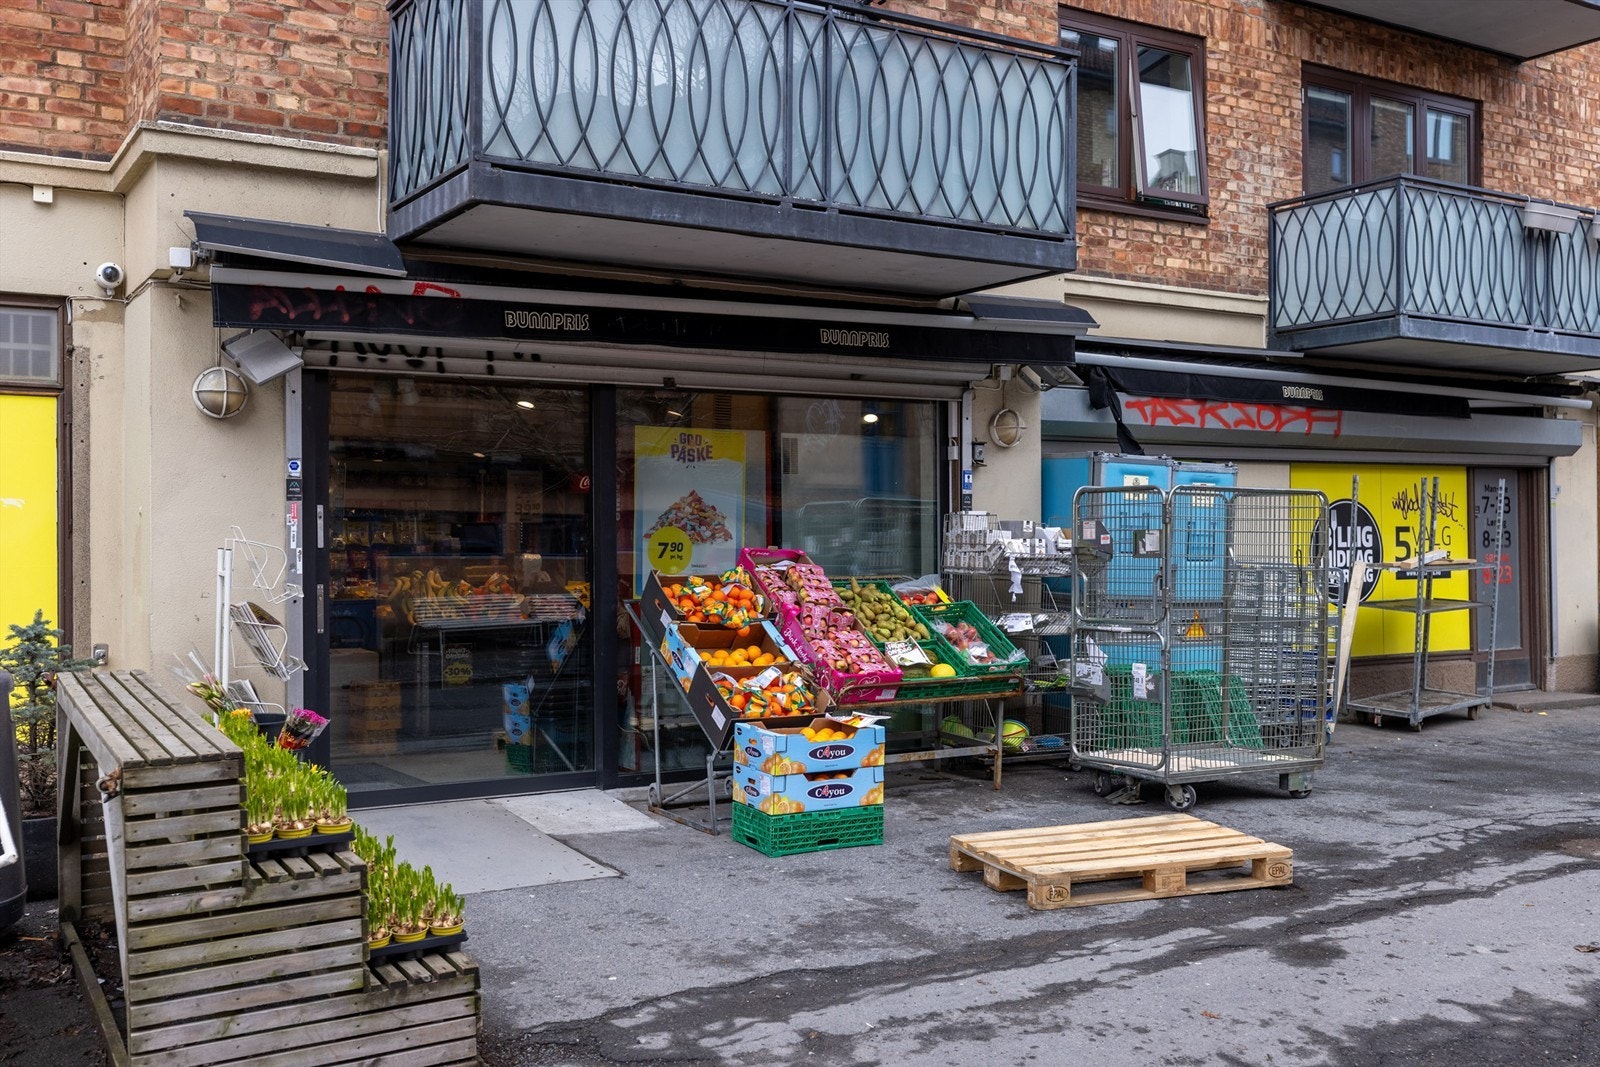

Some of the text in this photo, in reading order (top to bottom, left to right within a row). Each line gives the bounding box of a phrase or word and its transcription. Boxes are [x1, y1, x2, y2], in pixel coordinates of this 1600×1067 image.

[504, 310, 589, 331] BUNNPRIS
[820, 328, 889, 348] BUNNPRIS
[671, 444, 713, 463] PÅSKE
[1484, 484, 1508, 493] Man-e
[1481, 496, 1511, 514] 7-3
[1487, 518, 1507, 529] Lørg
[1411, 526, 1451, 546] VAG
[1483, 564, 1512, 584] 823
[816, 746, 846, 759] C4you
[815, 785, 845, 798] C4you
